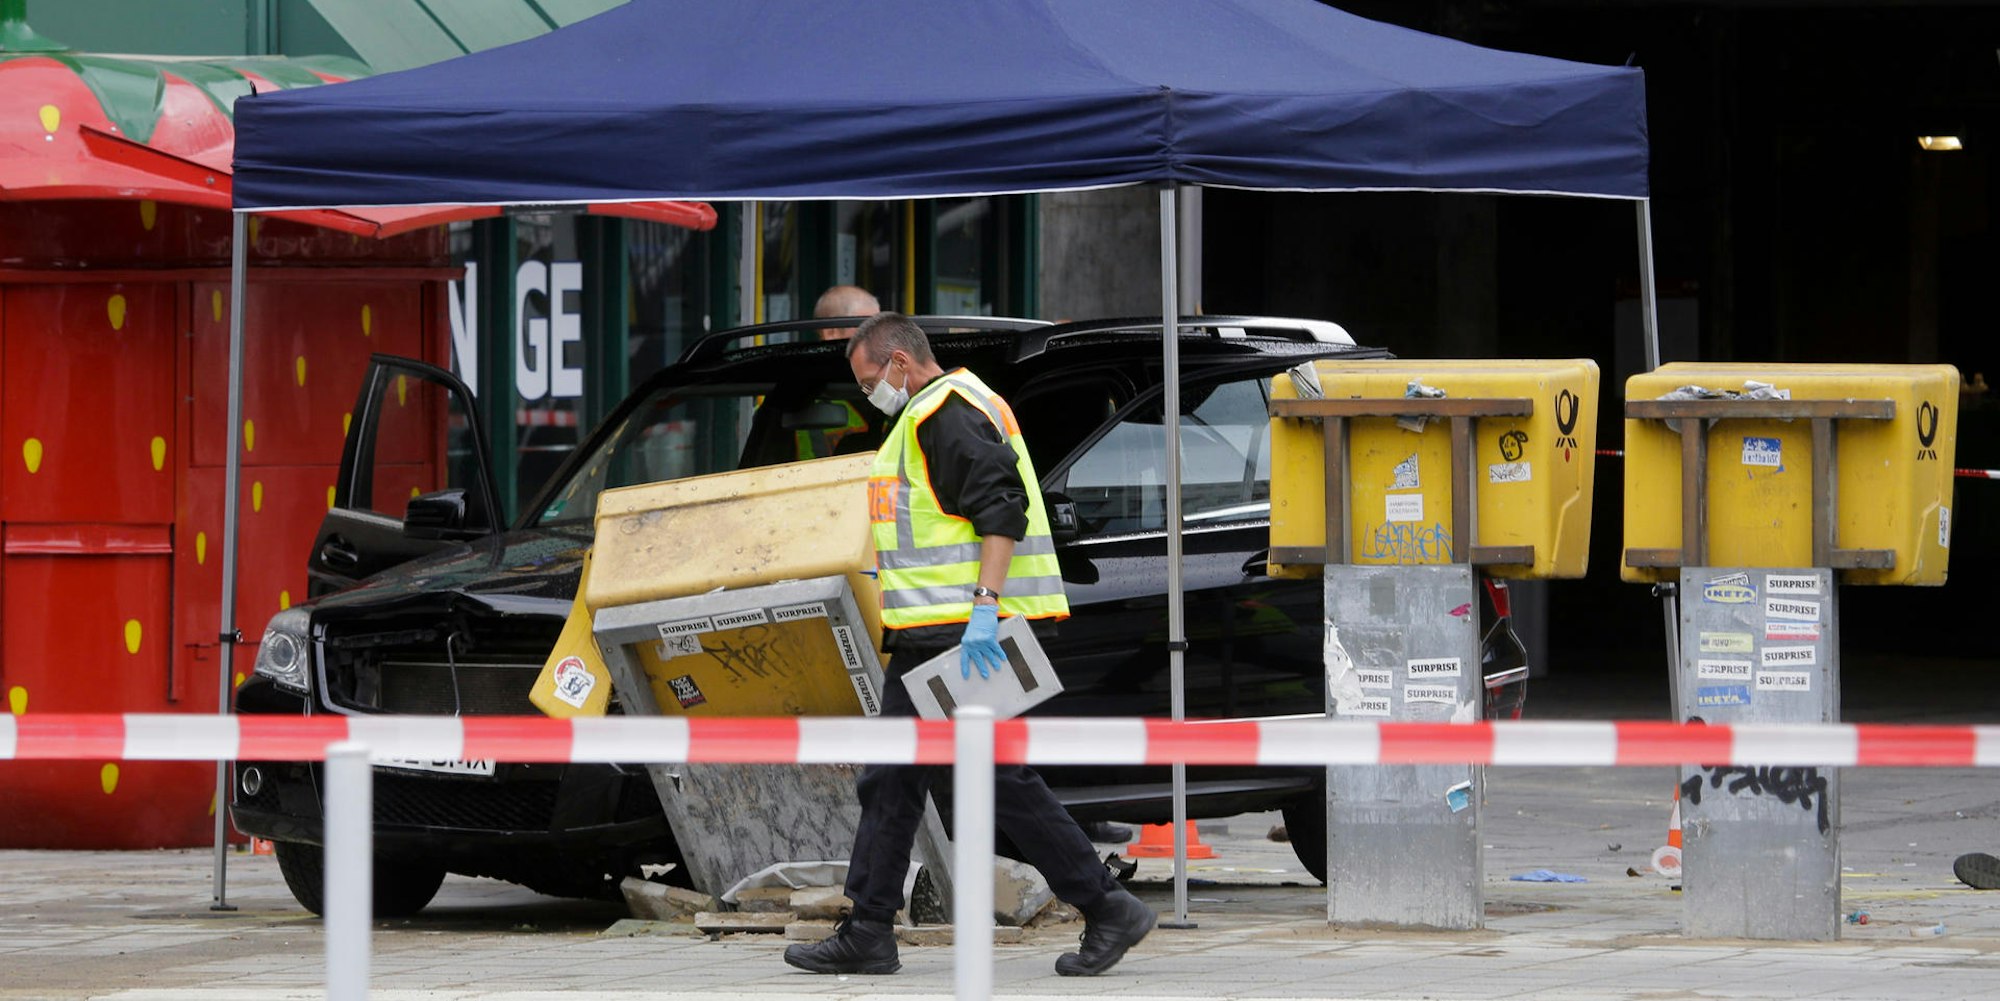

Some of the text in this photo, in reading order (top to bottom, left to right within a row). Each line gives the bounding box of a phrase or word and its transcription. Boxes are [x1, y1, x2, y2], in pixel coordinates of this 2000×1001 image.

[776, 605, 824, 619] SURPRISE
[1769, 603, 1817, 615] SURPRISE
[716, 612, 764, 626] SURPRISE
[662, 621, 710, 635] SURPRISE
[837, 628, 858, 666] SURPRISE
[1764, 650, 1813, 661] SURPRISE
[1411, 662, 1458, 673] SURPRISE
[855, 676, 878, 714] SURPRISE
[1406, 690, 1454, 698] SURPRISE
